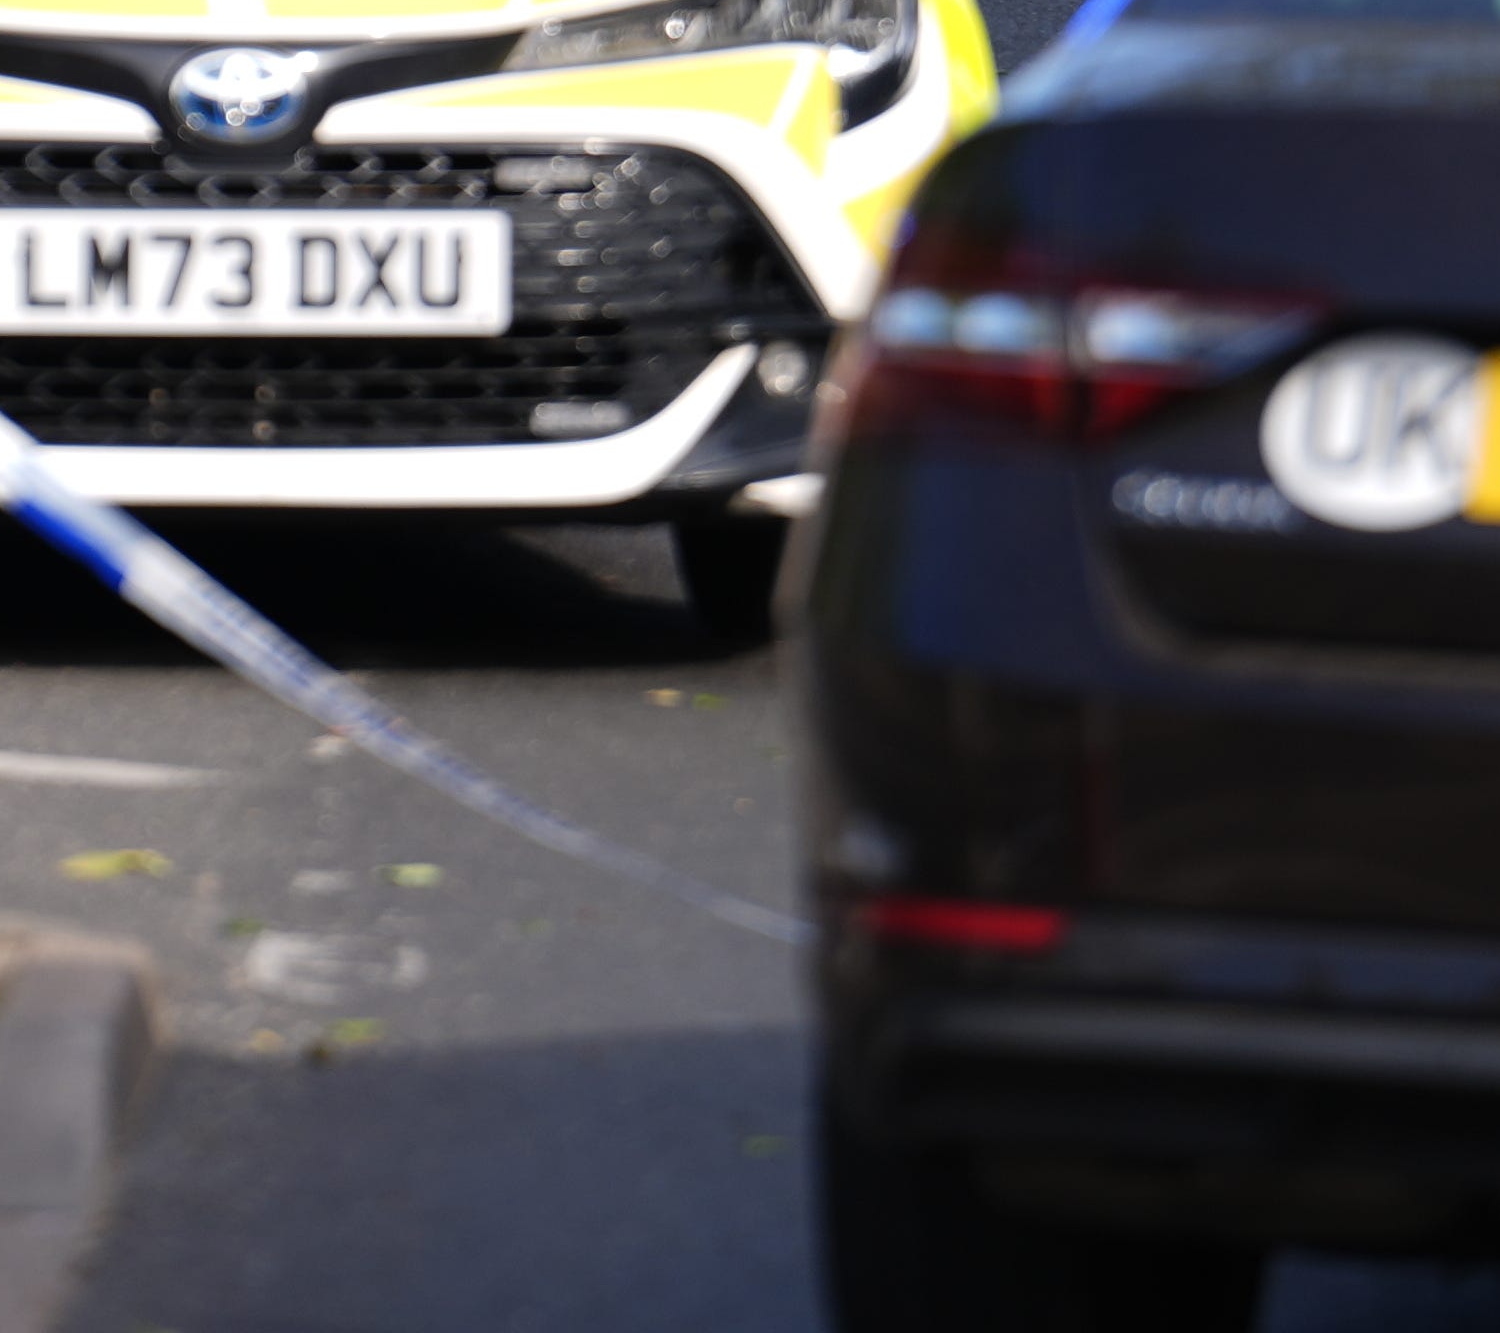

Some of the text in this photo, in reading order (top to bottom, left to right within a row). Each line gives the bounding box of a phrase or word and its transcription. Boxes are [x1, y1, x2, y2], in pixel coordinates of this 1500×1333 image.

[17, 229, 465, 309] LM73 DXU
[1303, 351, 1472, 475] UK
